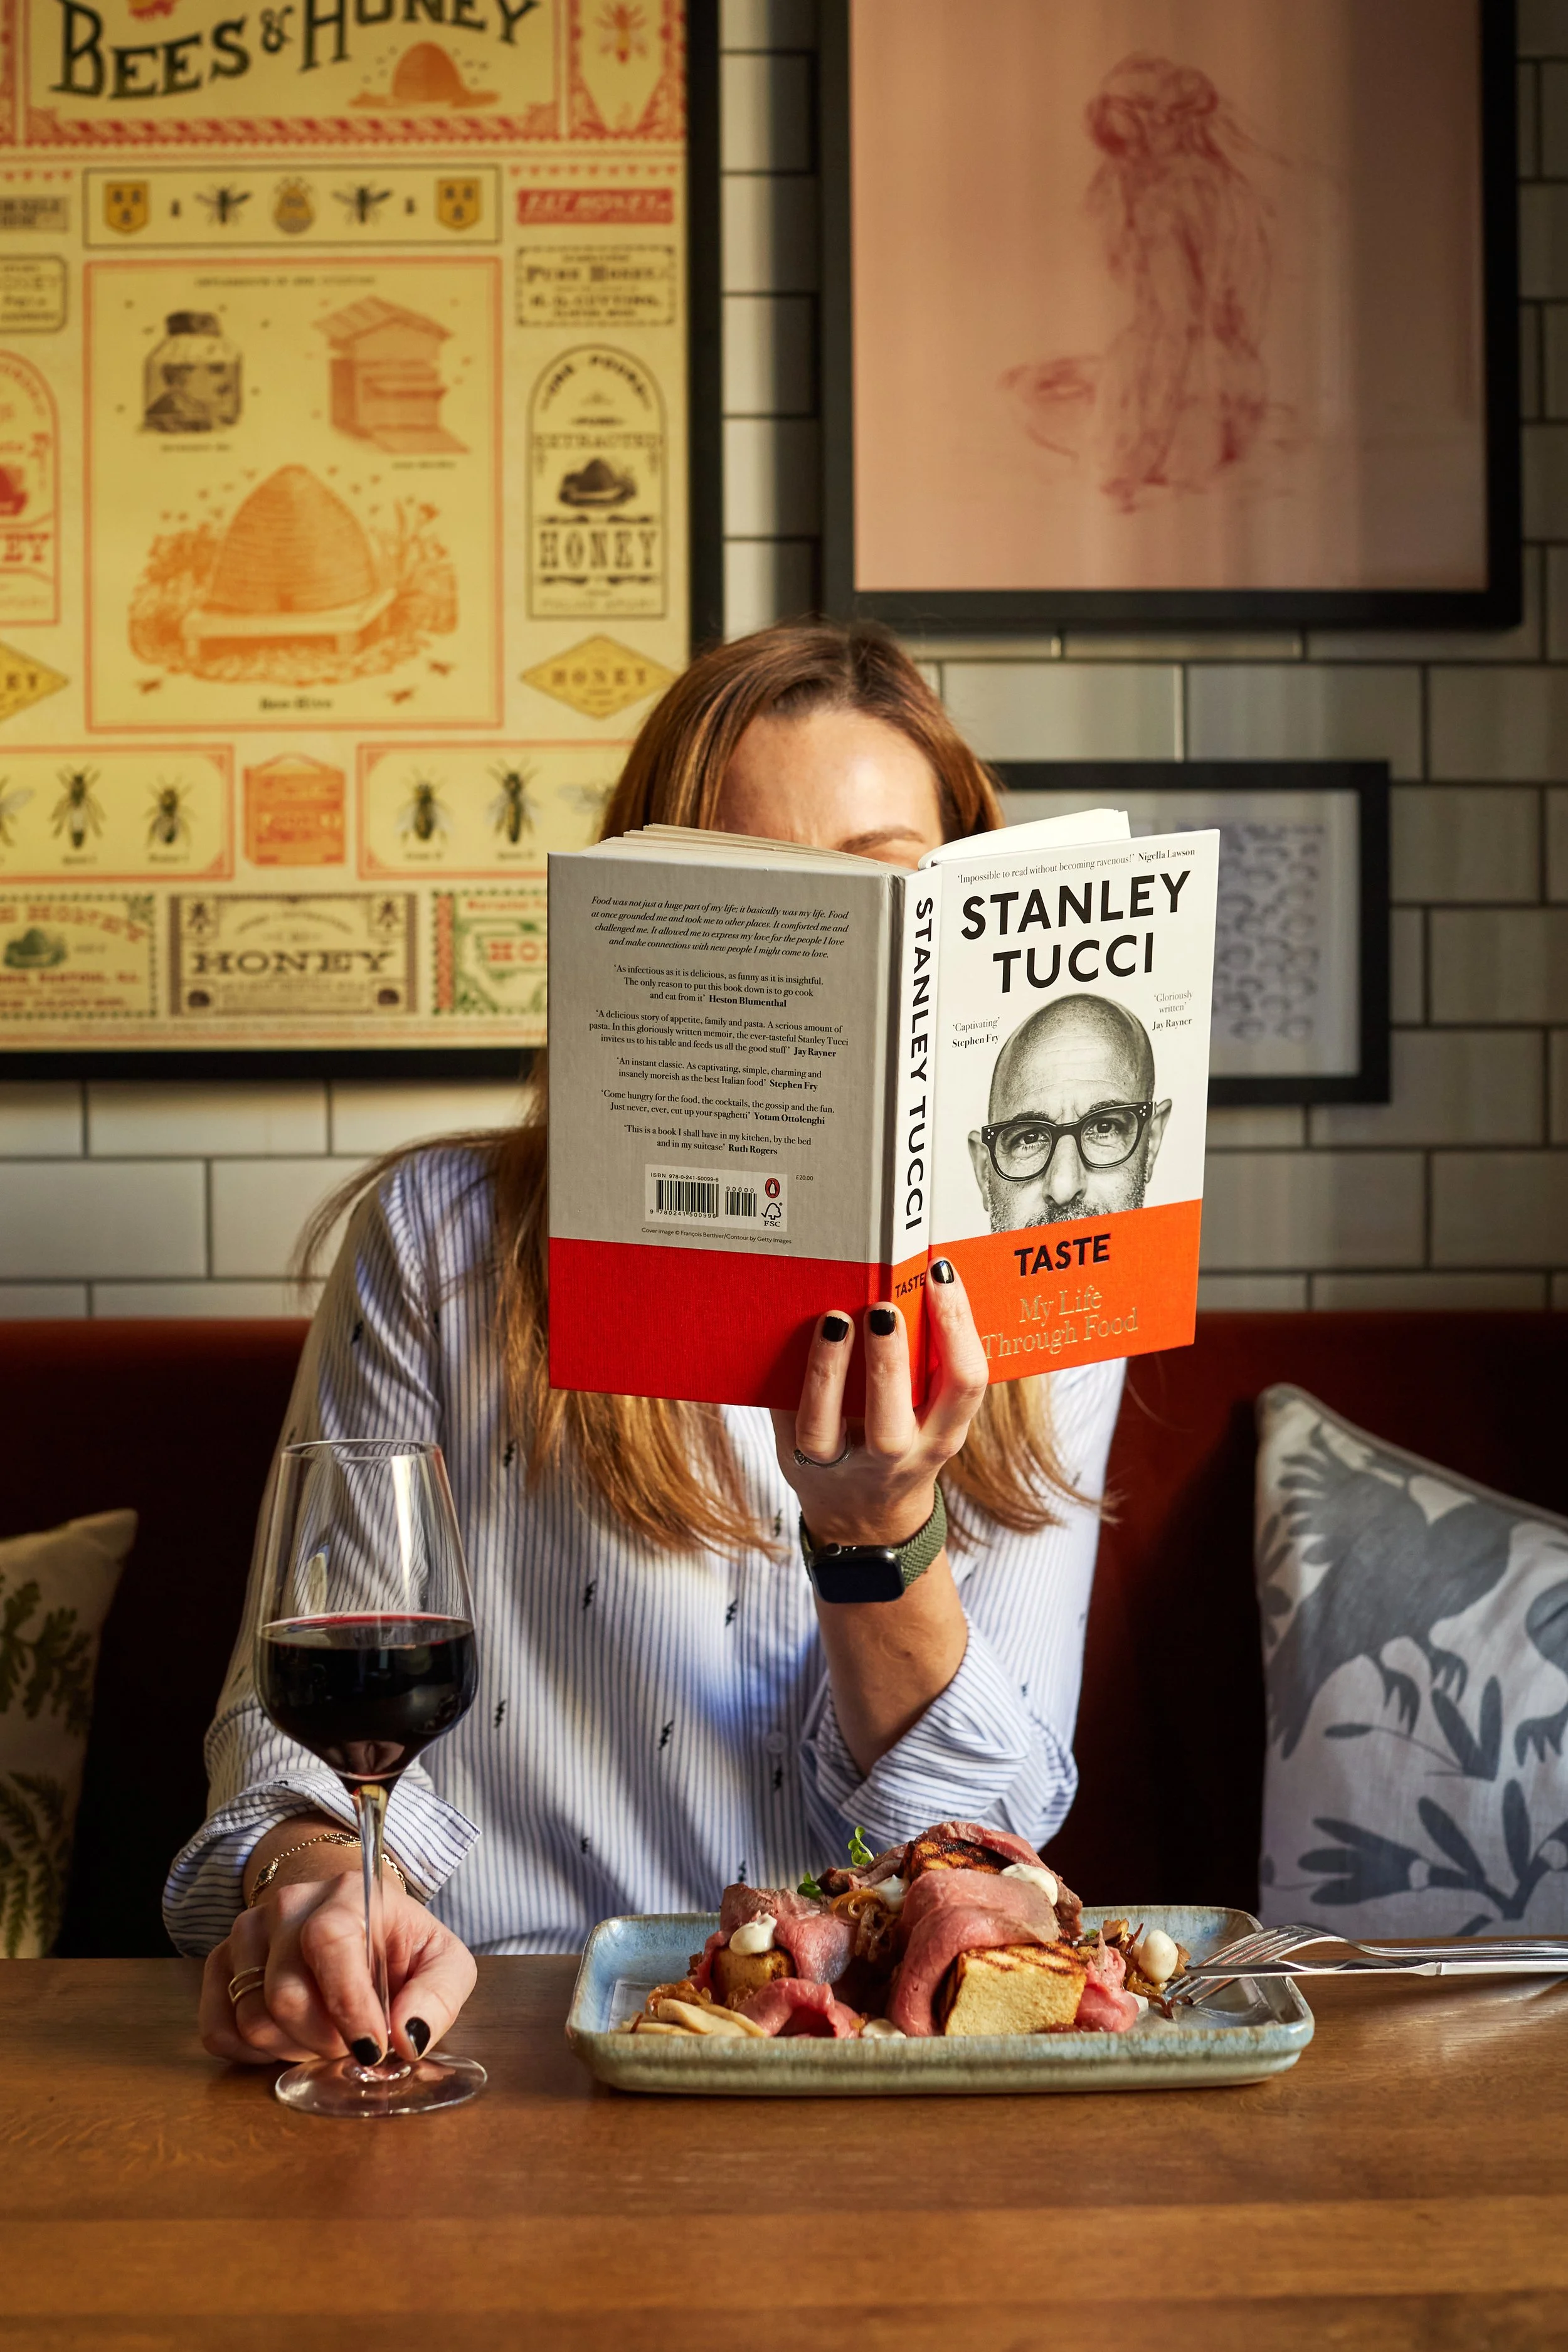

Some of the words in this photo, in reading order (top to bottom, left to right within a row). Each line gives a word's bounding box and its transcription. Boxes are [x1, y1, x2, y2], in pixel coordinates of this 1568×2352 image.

[48, 0, 252, 100] BEES
[260, 4, 294, 54] &
[539, 530, 657, 569] HONEY
[551, 667, 647, 686] HONEY
[958, 871, 1001, 885] ‘Impossible
[1012, 867, 1027, 877] read
[1029, 865, 1057, 874] without
[1059, 860, 1095, 871] becoming
[1097, 854, 1135, 866] ravenous!’
[1138, 850, 1165, 863] Nigella
[1167, 850, 1195, 858] Lawson
[591, 896, 612, 905] Food
[640, 899, 657, 909] just
[664, 901, 683, 912] huge
[682, 904, 701, 912] part
[701, 903, 712, 913] of
[711, 906, 723, 914] my
[724, 904, 738, 914] life;
[746, 905, 781, 918] basically
[798, 911, 812, 919] my
[812, 909, 825, 920] life.
[828, 910, 849, 919] Food
[961, 871, 1191, 940] STANLEY
[193, 950, 394, 975] HONEY
[993, 932, 1153, 993] TUCCI
[614, 964, 627, 973] ‘As
[628, 965, 665, 975] infectious
[690, 969, 726, 980] delicious,
[738, 972, 759, 983] funny
[770, 974, 776, 982] it
[778, 975, 784, 983] is
[785, 975, 824, 986] insightful.
[623, 977, 638, 986] The
[640, 978, 657, 989] only
[694, 983, 707, 992] put
[708, 983, 722, 991] this
[723, 983, 743, 992] book
[744, 985, 765, 993] down
[766, 986, 773, 994] is
[795, 988, 813, 997] cook
[678, 993, 696, 1002] from
[709, 995, 738, 1004] Heston
[739, 997, 787, 1007] Blumenthal
[910, 898, 933, 1082] STANLEY
[596, 1009, 605, 1017] ‘A
[606, 1010, 640, 1020] delicious
[640, 1014, 660, 1024] story
[660, 1014, 670, 1022] of
[670, 1016, 702, 1025] appetite,
[705, 1017, 728, 1028] family
[728, 1019, 743, 1027] and
[744, 1021, 765, 1029] pasta.
[775, 1022, 803, 1030] serious
[953, 1017, 1000, 1033] ‘Captivating’
[1152, 1021, 1163, 1031] Jay
[1166, 1019, 1192, 1029] Rayner
[952, 1037, 984, 1049] Stephen
[986, 1034, 1000, 1044] Fry
[617, 1057, 630, 1066] ‘An
[632, 1058, 657, 1067] instant
[658, 1060, 684, 1069] classic.
[697, 1064, 741, 1075] captivating,
[742, 1066, 770, 1076] simple,
[771, 1067, 807, 1079] charming
[618, 1069, 649, 1081] insanely
[650, 1073, 680, 1081] moreish
[691, 1074, 702, 1083] the
[704, 1075, 720, 1084] best
[722, 1076, 745, 1085] Italian
[747, 1078, 766, 1086] food’
[770, 1079, 802, 1090] Stephen
[804, 1081, 818, 1093] Fry
[624, 1124, 643, 1133] ‘This
[645, 1126, 651, 1134] is
[658, 1126, 677, 1136] book
[683, 1129, 700, 1137] shall
[701, 1130, 718, 1139] have
[720, 1131, 728, 1140] in
[741, 1133, 771, 1143] kitchen,
[773, 1135, 783, 1145] by
[784, 1136, 796, 1144] the
[798, 1137, 812, 1145] bed
[672, 1140, 679, 1148] in
[681, 1143, 692, 1151] my
[694, 1142, 725, 1151] suitcase’
[728, 1144, 748, 1153] Ruth
[750, 1145, 778, 1157] Rogers
[906, 1095, 926, 1230] TUCCI
[669, 1173, 719, 1182] 978-0-241-50099-6
[1014, 1233, 1111, 1277] TASTE
[894, 1272, 926, 1298] TASTE
[1019, 1295, 1054, 1327] My
[1058, 1285, 1103, 1316] Life
[981, 1320, 1078, 1360] Through
[1083, 1306, 1138, 1341] Food
